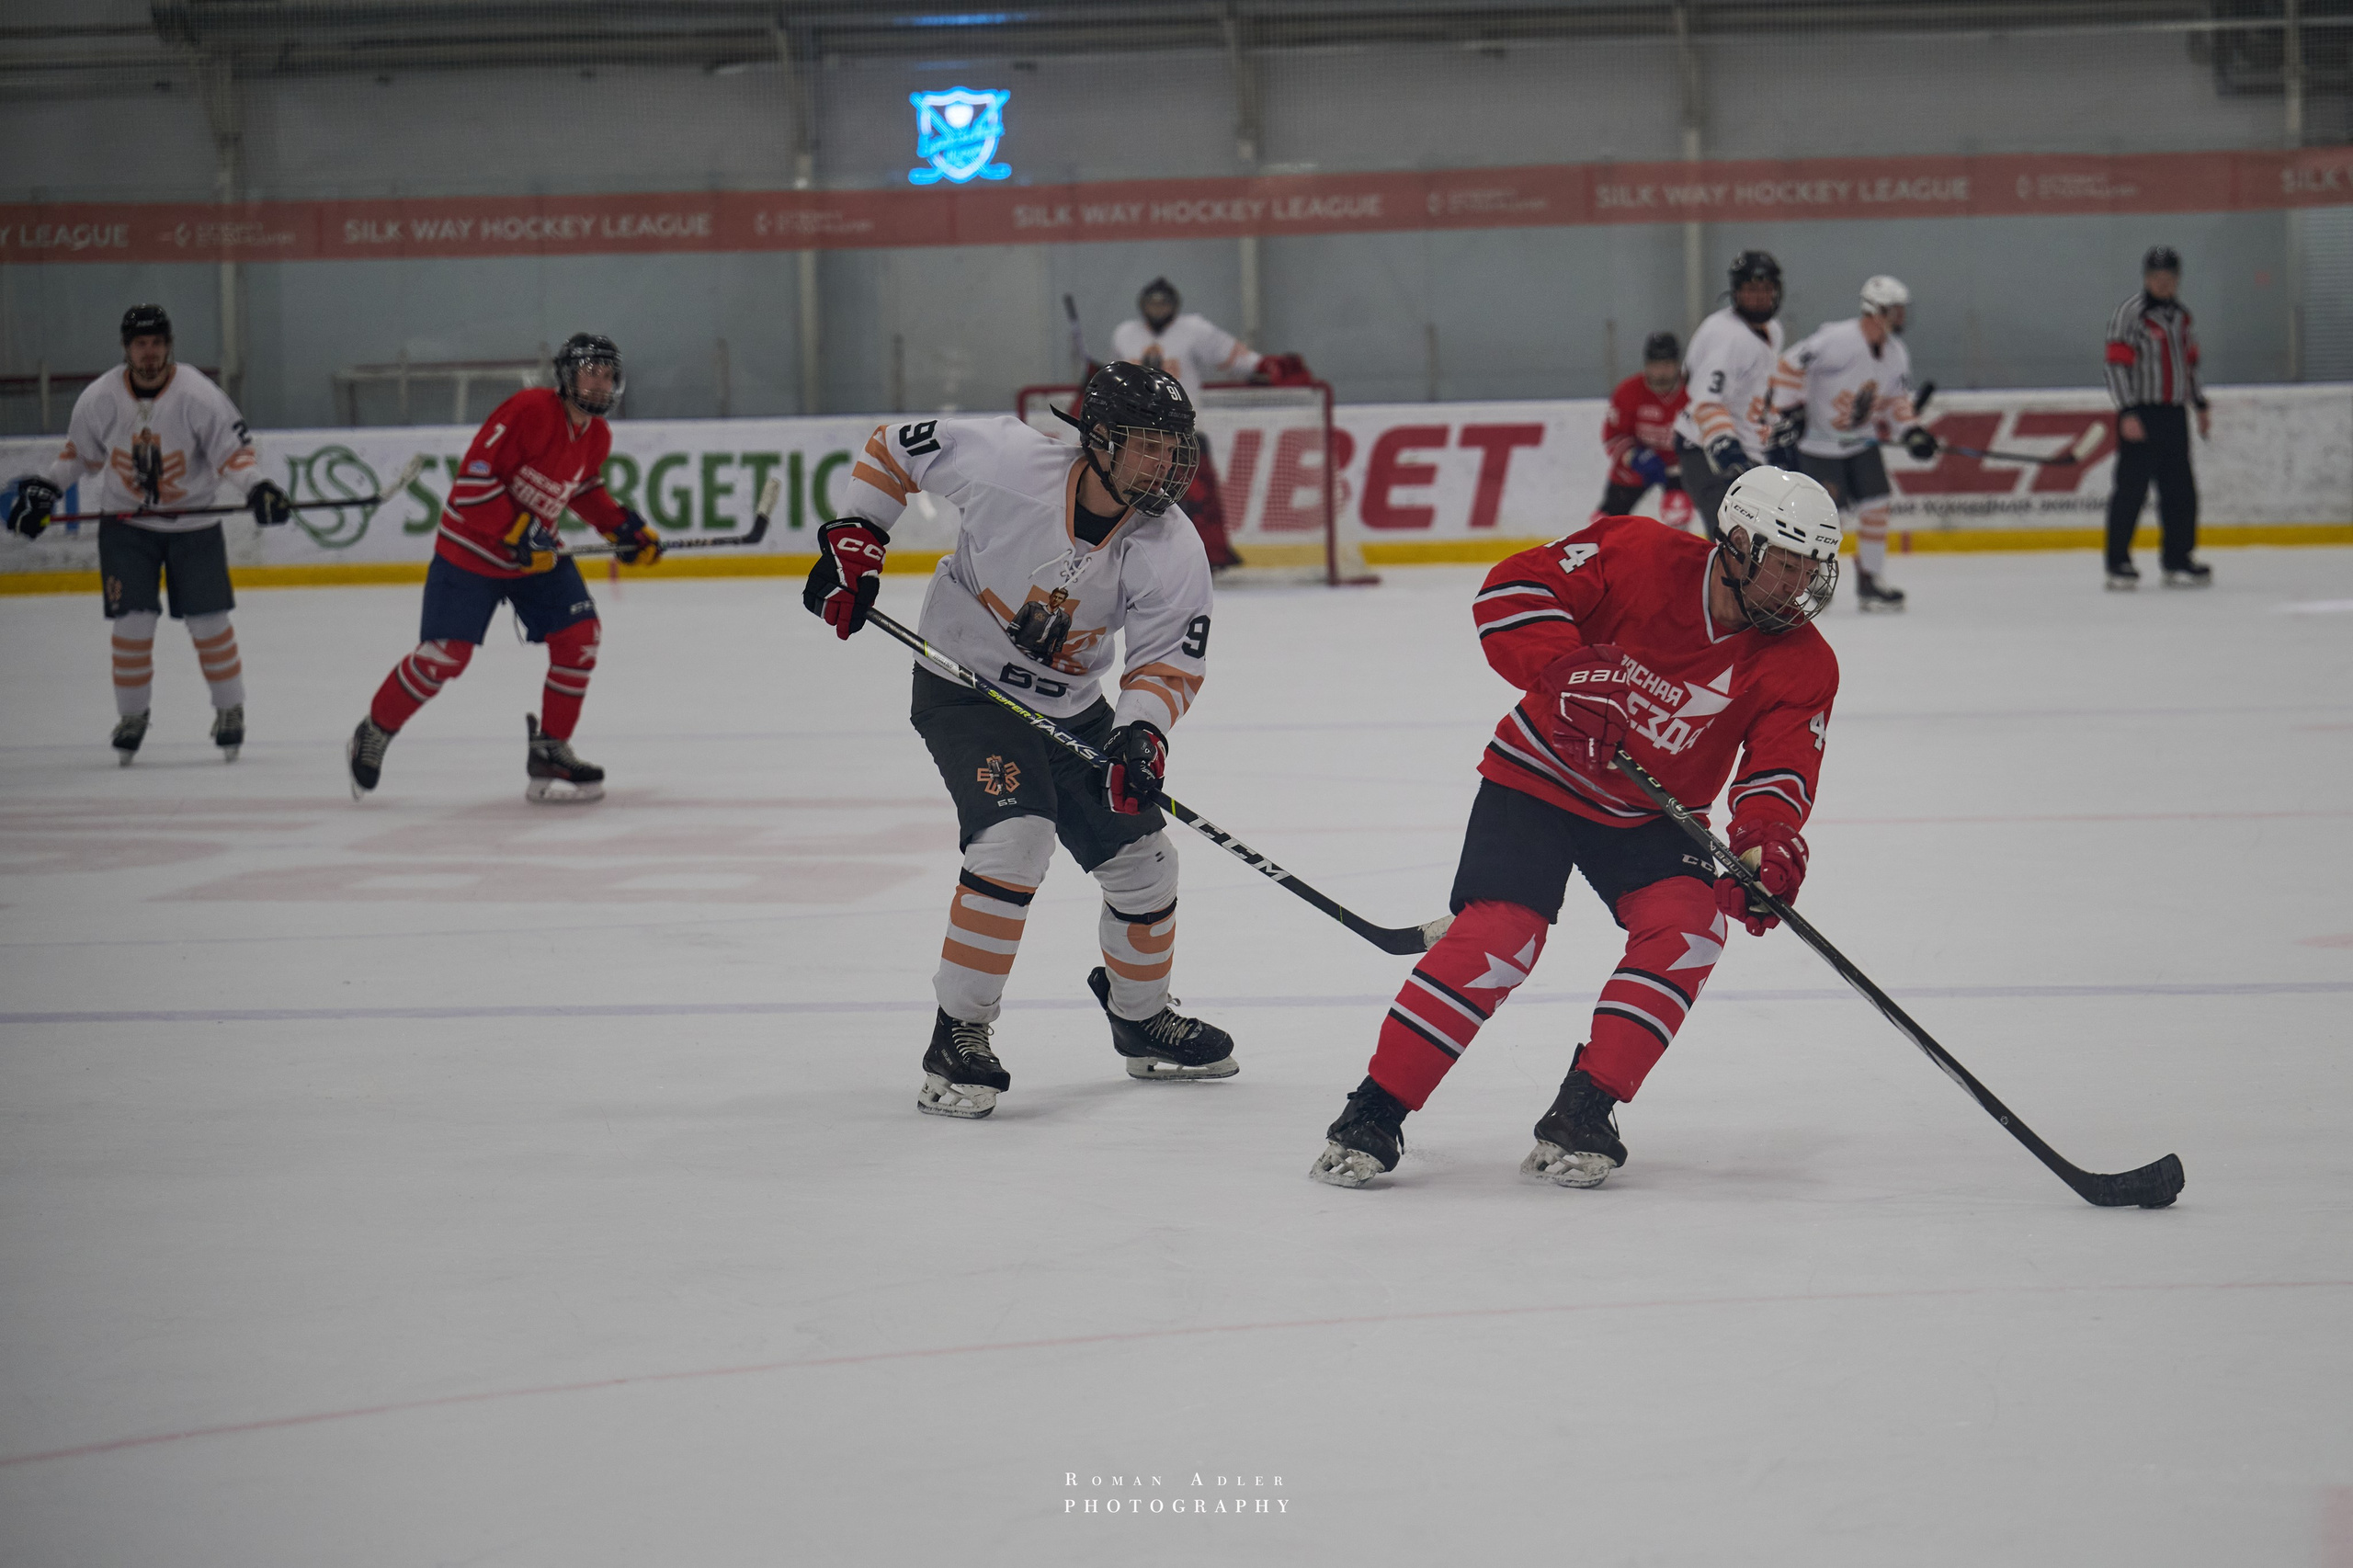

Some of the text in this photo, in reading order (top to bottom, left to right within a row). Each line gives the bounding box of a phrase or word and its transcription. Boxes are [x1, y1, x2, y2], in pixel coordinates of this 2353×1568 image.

[1596, 176, 1968, 208] SILK WAY HOCKEY LEAGUE
[1012, 194, 1381, 228] SILK WAY HOCKEY LEAGUE
[19, 223, 130, 248] LEAGUE
[344, 212, 712, 244] SILK WAY HOCKEY LEAGUE
[1165, 385, 1183, 402] 91
[1708, 369, 1725, 394] 3
[233, 420, 252, 446] 2
[899, 419, 942, 457] 91
[1733, 504, 1755, 520] CCM
[1814, 535, 1839, 546] CCM
[1181, 614, 1211, 660] 9
[986, 688, 1100, 761] SUPER TACKS
[1188, 814, 1291, 882] CCM
[1681, 853, 1719, 877] CC
